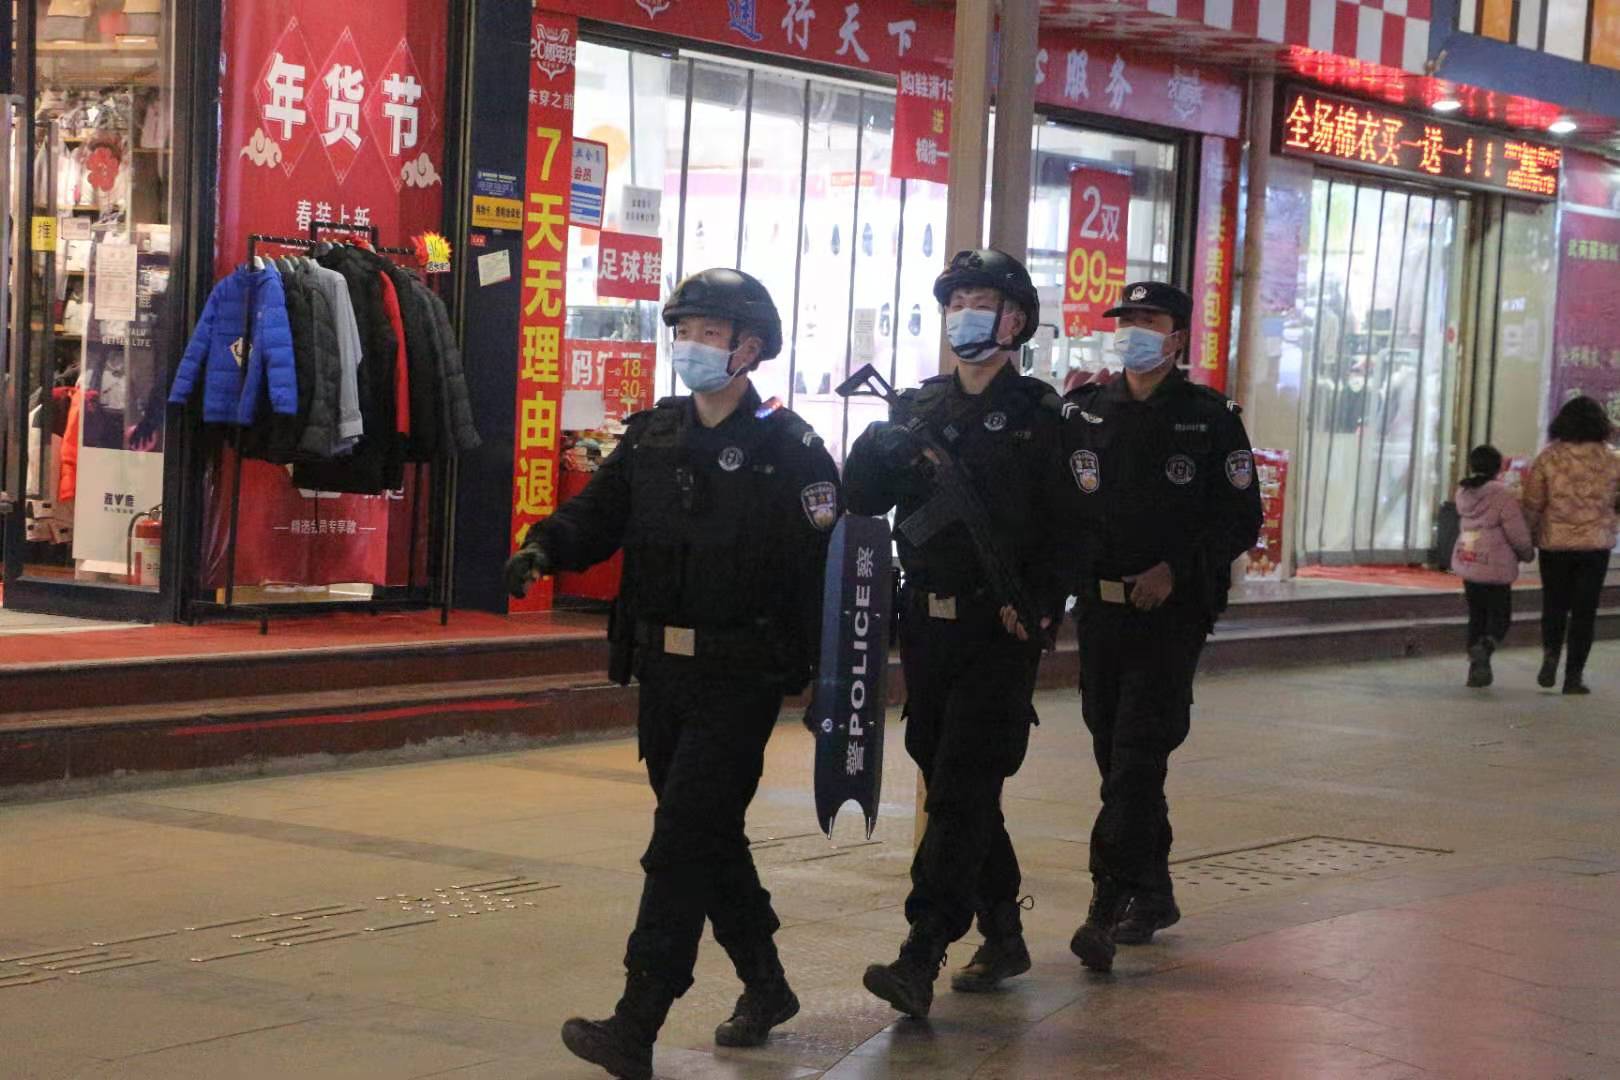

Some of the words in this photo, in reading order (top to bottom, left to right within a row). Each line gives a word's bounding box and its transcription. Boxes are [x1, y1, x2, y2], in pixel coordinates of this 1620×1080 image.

[263, 51, 423, 157] 年货节
[527, 88, 575, 111] 未穿之前
[1079, 186, 1121, 242] 2双
[600, 248, 661, 285] 足球鞋
[1068, 247, 1127, 304] 99元
[849, 585, 871, 737] POLICE
